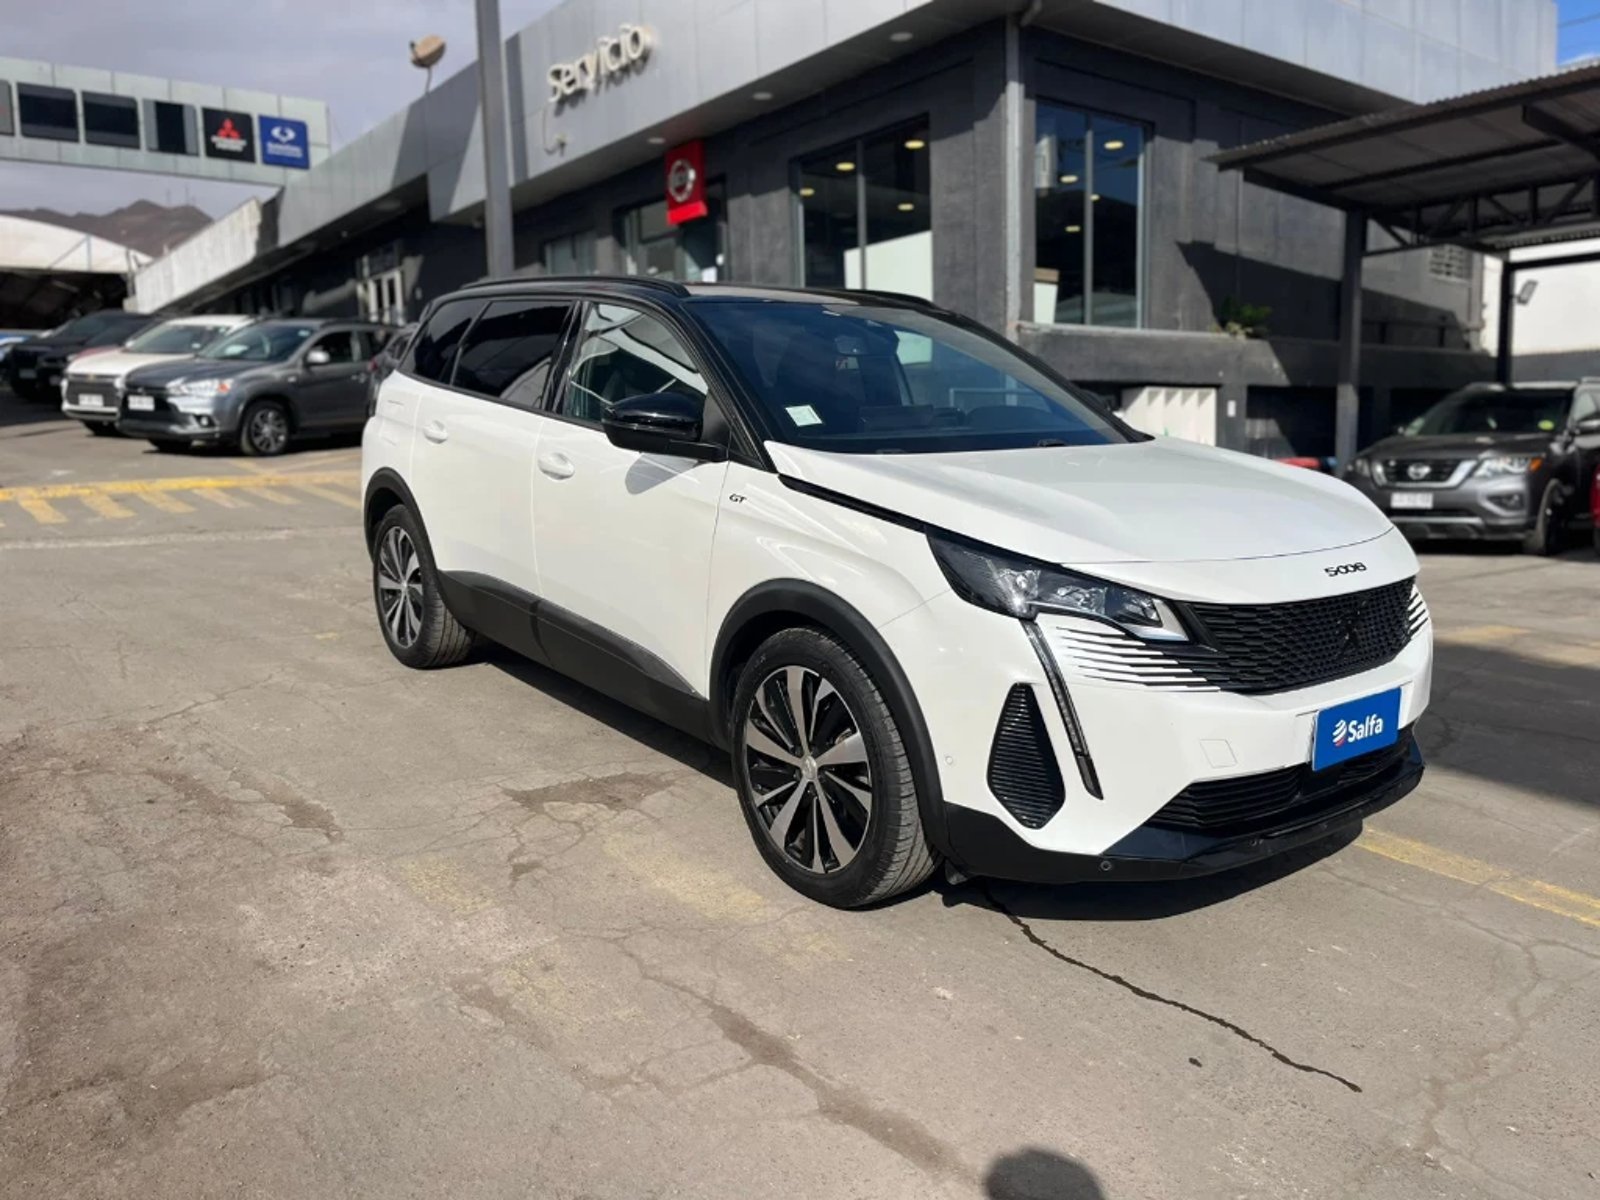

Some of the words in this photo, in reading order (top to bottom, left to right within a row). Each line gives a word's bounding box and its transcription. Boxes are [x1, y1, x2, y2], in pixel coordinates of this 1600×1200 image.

[729, 493, 748, 504] GT
[1324, 561, 1367, 577] 5008
[1347, 713, 1384, 743] Salfa
